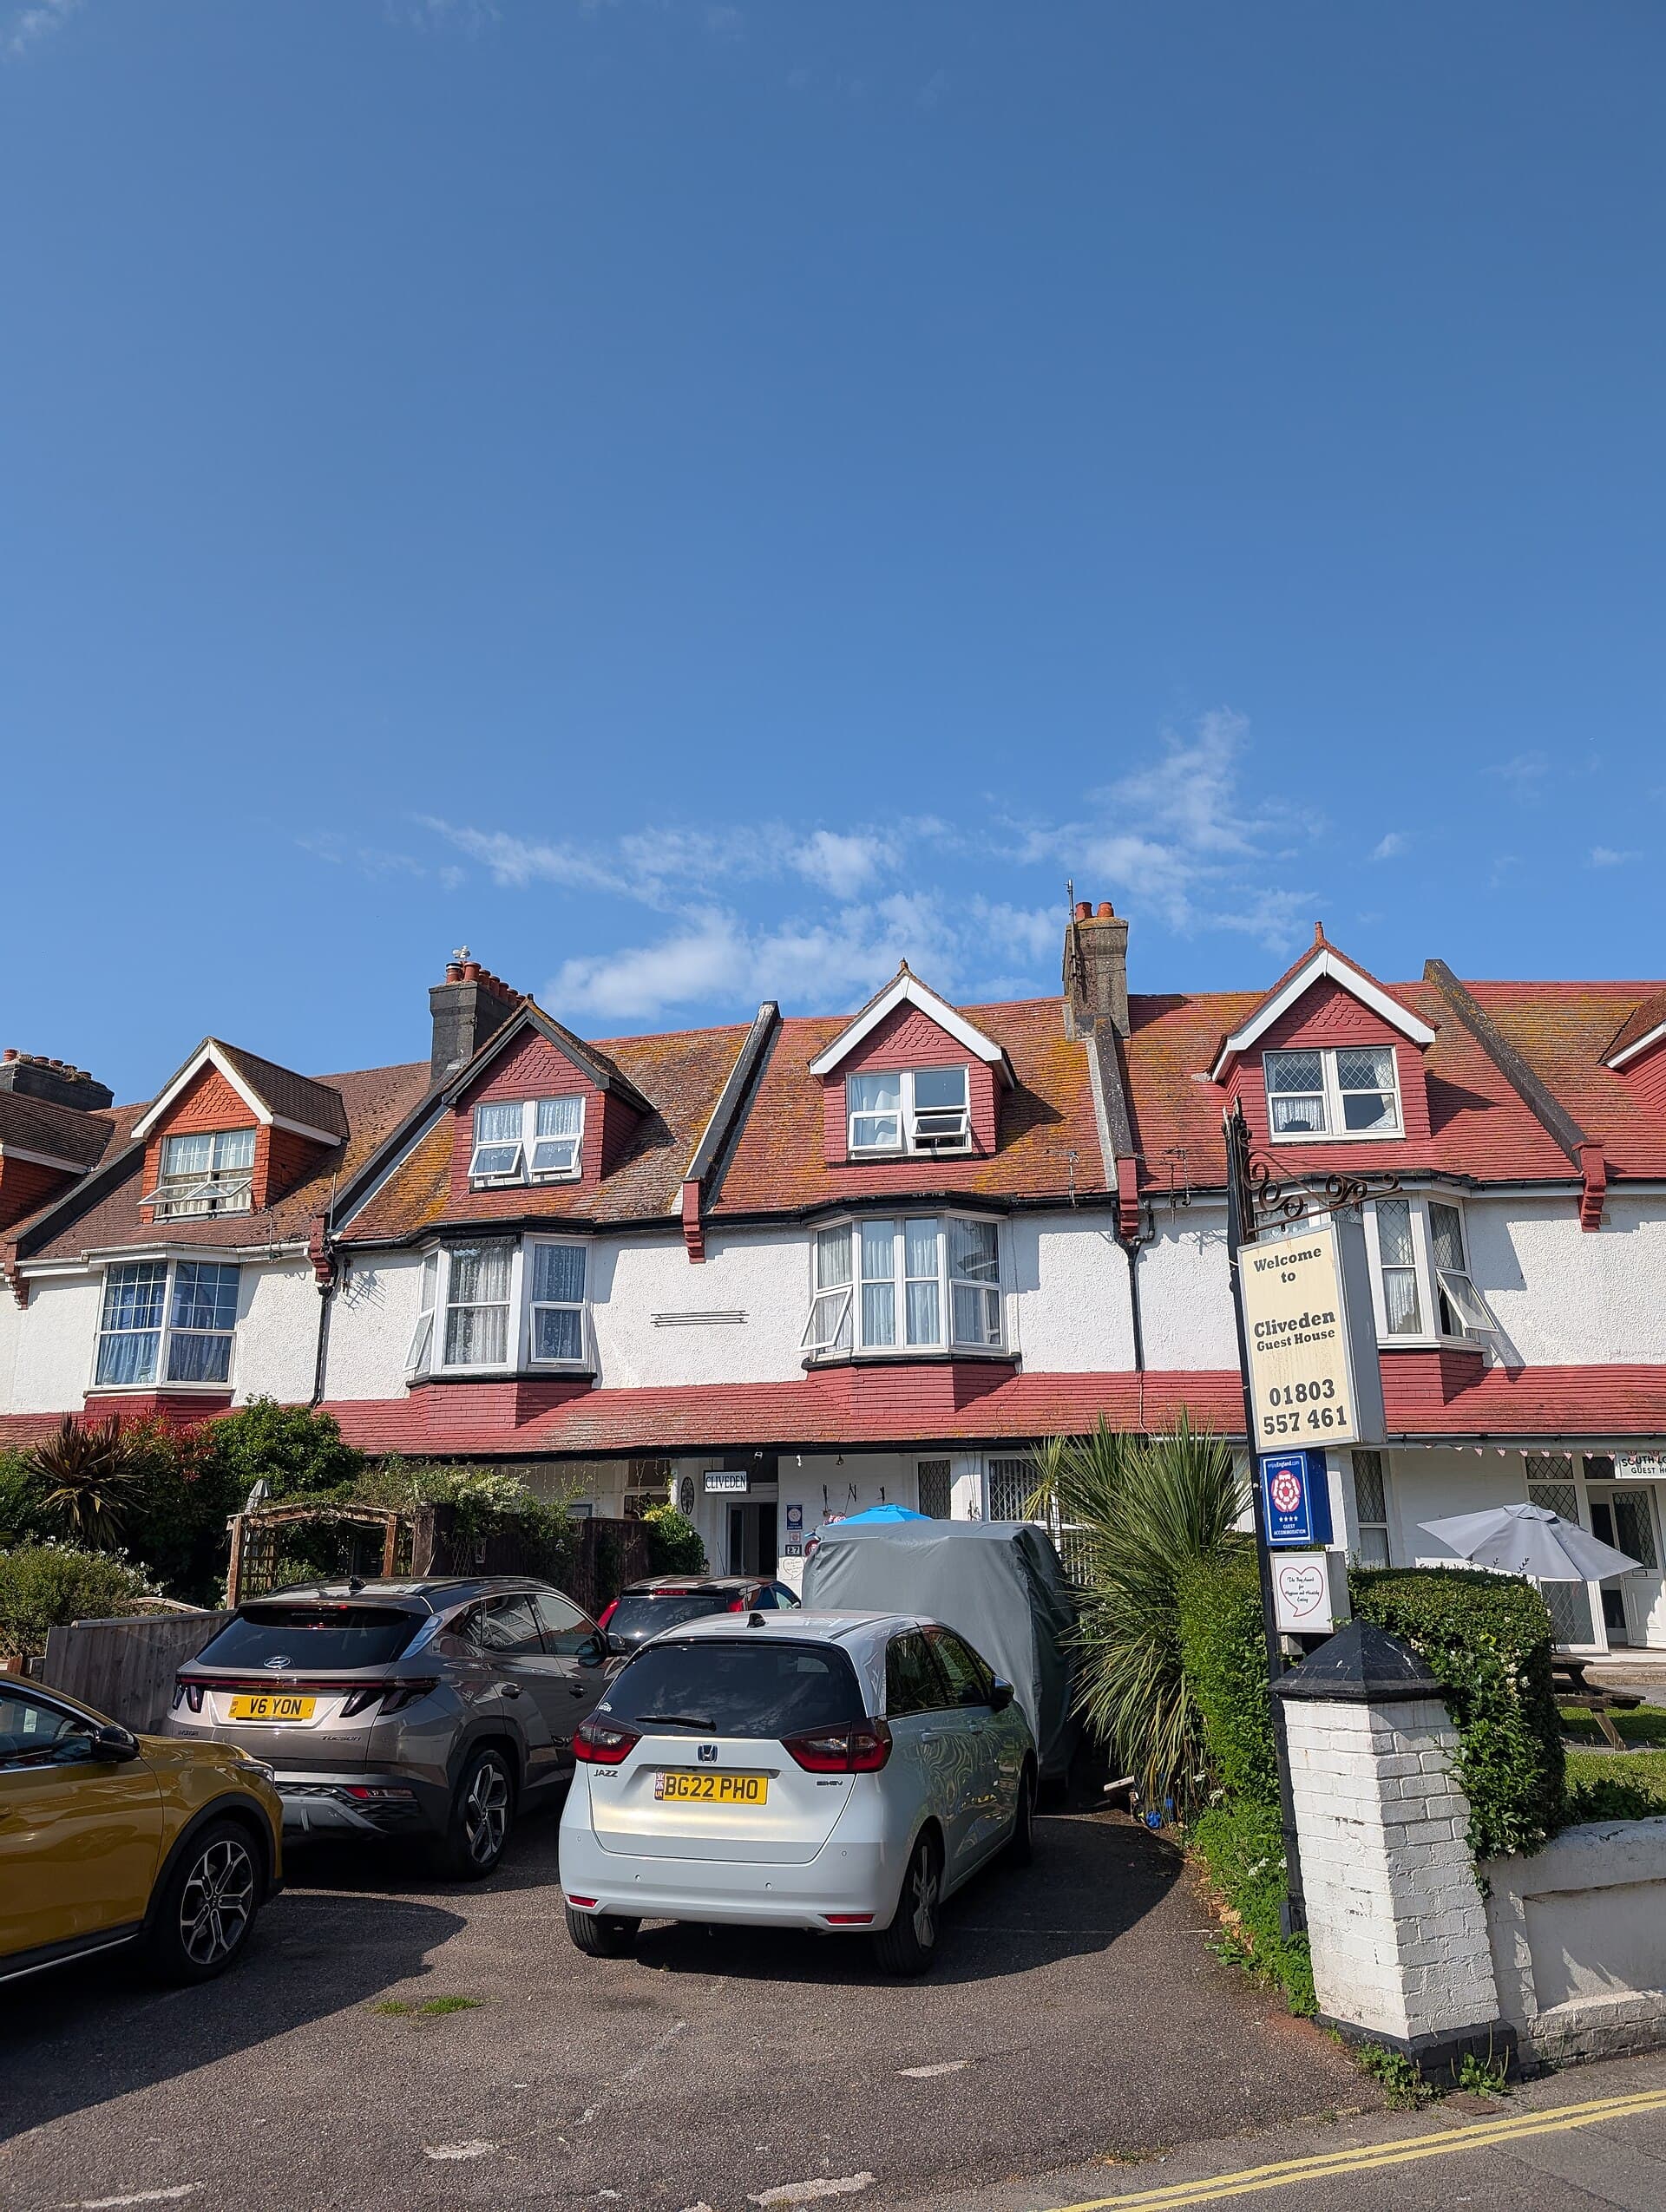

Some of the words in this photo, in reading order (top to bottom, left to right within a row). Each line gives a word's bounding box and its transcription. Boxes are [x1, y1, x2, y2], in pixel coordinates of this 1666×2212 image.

[1254, 1248, 1322, 1272] Welcome
[1281, 1272, 1296, 1283] to
[1254, 1312, 1335, 1338] Cliveden
[1256, 1337, 1291, 1351] Guest
[1294, 1330, 1335, 1345] House
[1269, 1379, 1335, 1406] 01803
[1263, 1412, 1300, 1435] 557
[1308, 1405, 1347, 1429] 461
[705, 1475, 746, 1489] CLIVEDEN
[249, 1698, 267, 1714] V6
[273, 1698, 302, 1715] YON
[594, 1769, 619, 1778] JAZZ
[665, 1776, 715, 1797] BG22
[719, 1777, 758, 1800] PHO
